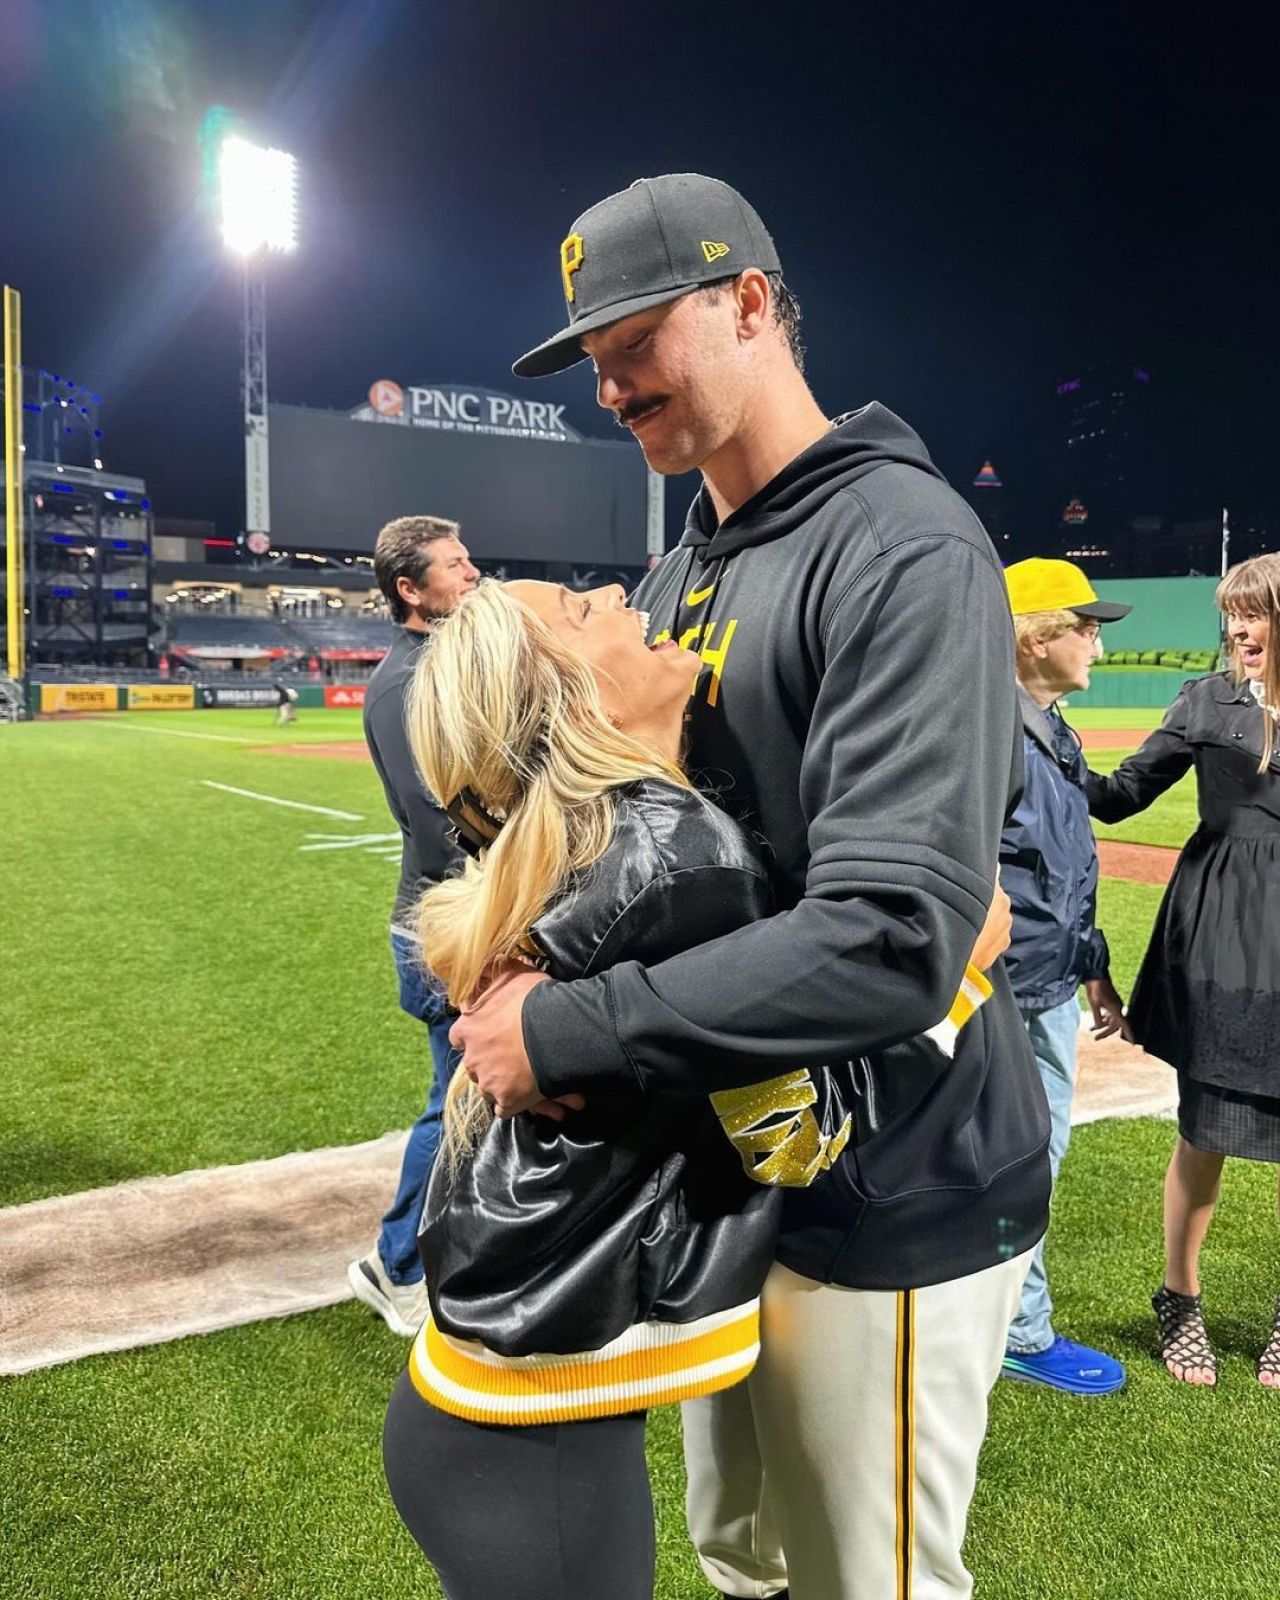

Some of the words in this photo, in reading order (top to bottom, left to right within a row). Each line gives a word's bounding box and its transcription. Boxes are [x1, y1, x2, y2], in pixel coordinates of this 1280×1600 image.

[560, 232, 584, 303] P
[408, 386, 480, 423] PNC
[486, 396, 567, 431] PARK
[412, 418, 440, 429] HOME
[441, 420, 455, 430] OF
[456, 422, 475, 432] THE
